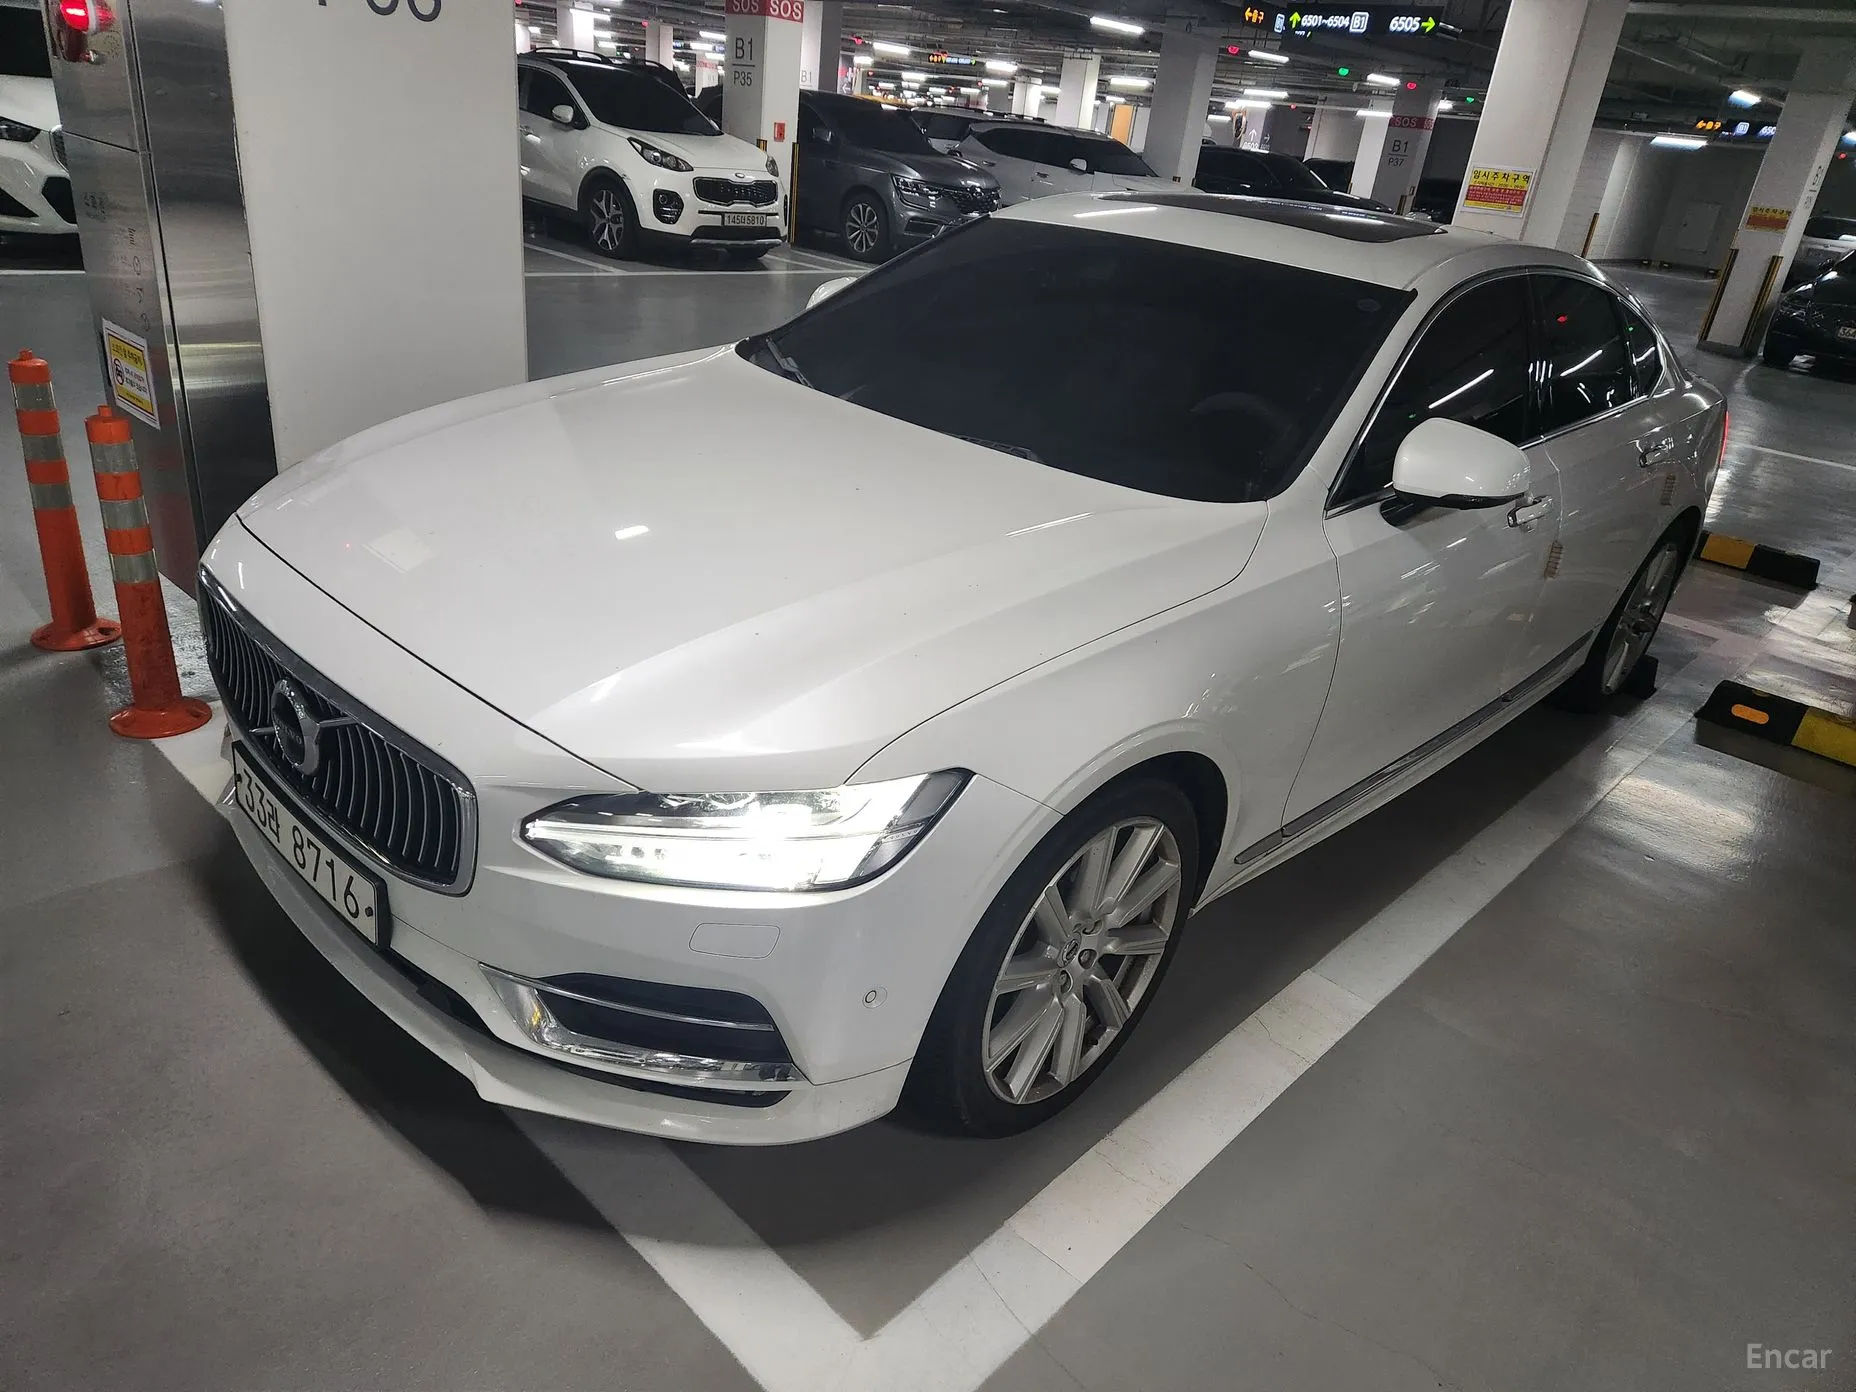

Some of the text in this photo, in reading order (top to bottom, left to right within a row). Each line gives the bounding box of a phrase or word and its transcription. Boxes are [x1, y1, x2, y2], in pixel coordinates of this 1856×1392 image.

[732, 0, 759, 13] SOS
[770, 0, 802, 20] SOS
[1301, 14, 1350, 28] 6501~6504
[1389, 16, 1421, 33] 6505
[735, 37, 753, 60] B1
[733, 70, 753, 87] P35
[801, 70, 812, 84] B1
[1394, 116, 1417, 128] SOS
[1392, 139, 1408, 153] B1
[1388, 157, 1404, 167] P37
[1473, 169, 1531, 184] 임시주차구역
[243, 768, 360, 919] 33라 8716
